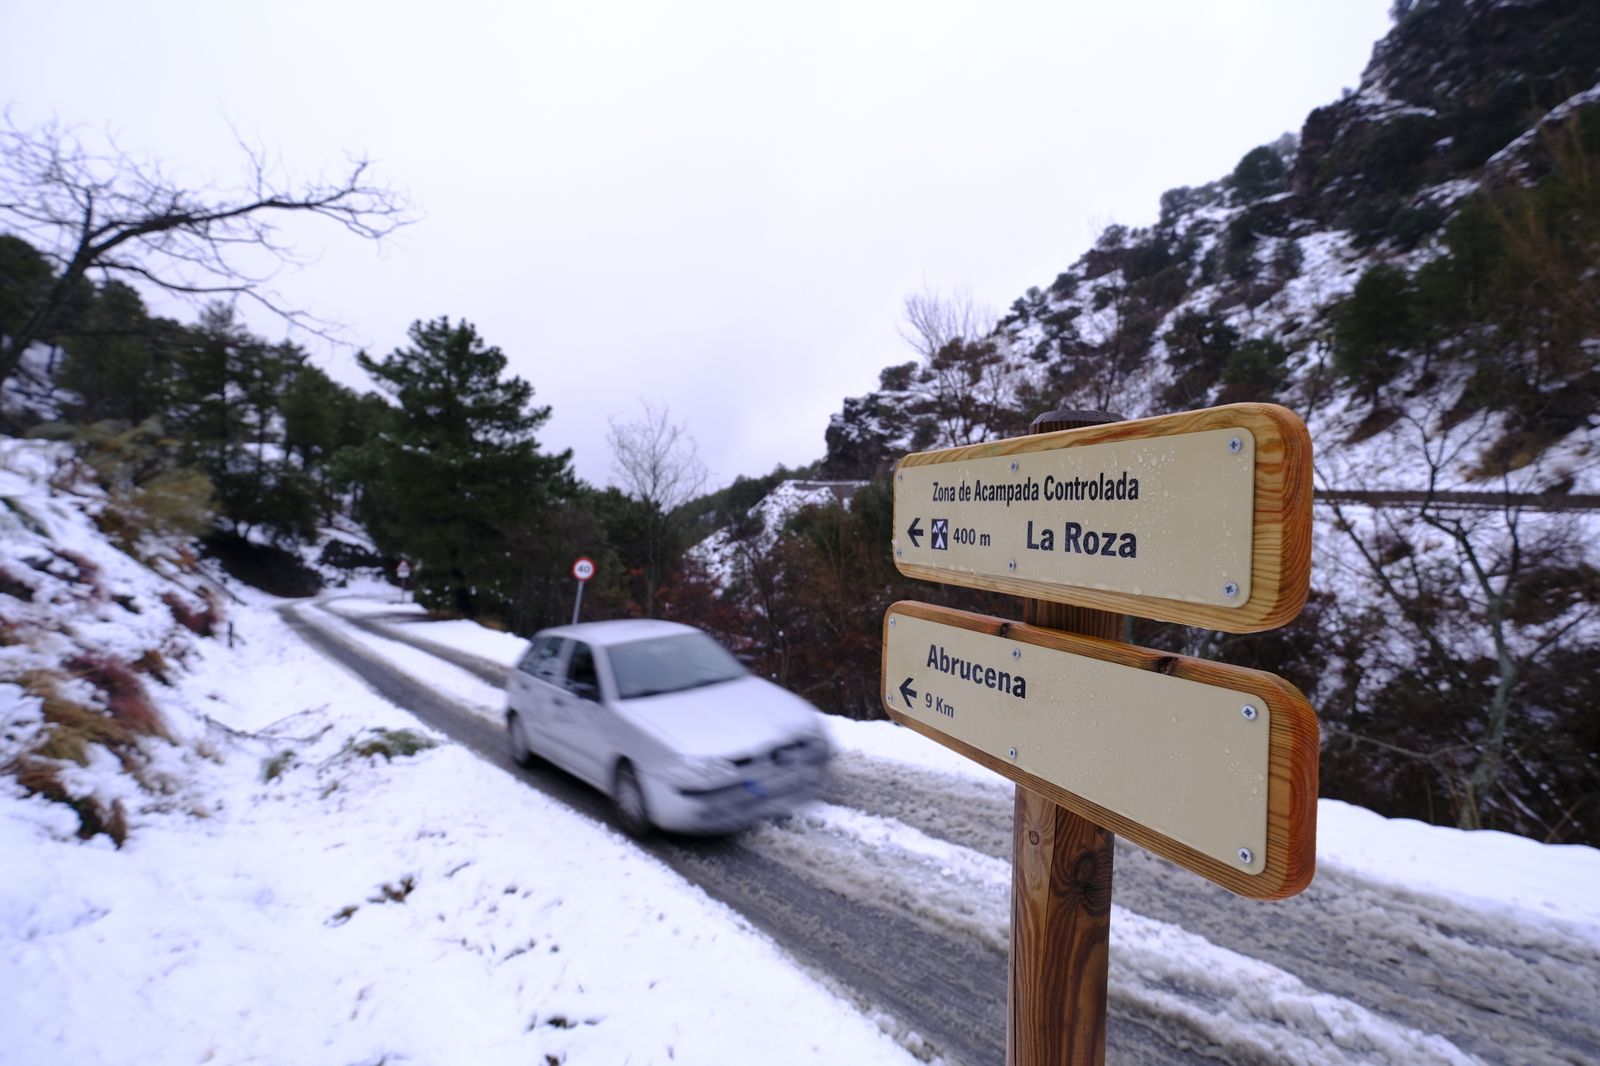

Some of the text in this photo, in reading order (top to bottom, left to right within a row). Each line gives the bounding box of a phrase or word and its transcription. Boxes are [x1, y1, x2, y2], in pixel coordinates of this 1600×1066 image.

[933, 471, 1139, 506] Zona de Acampada Controlada
[953, 527, 991, 547] 400 m
[1026, 520, 1137, 559] La Roza
[577, 565, 591, 573] 40
[926, 644, 1027, 699] Abrucena
[925, 693, 954, 718] 9 Km
